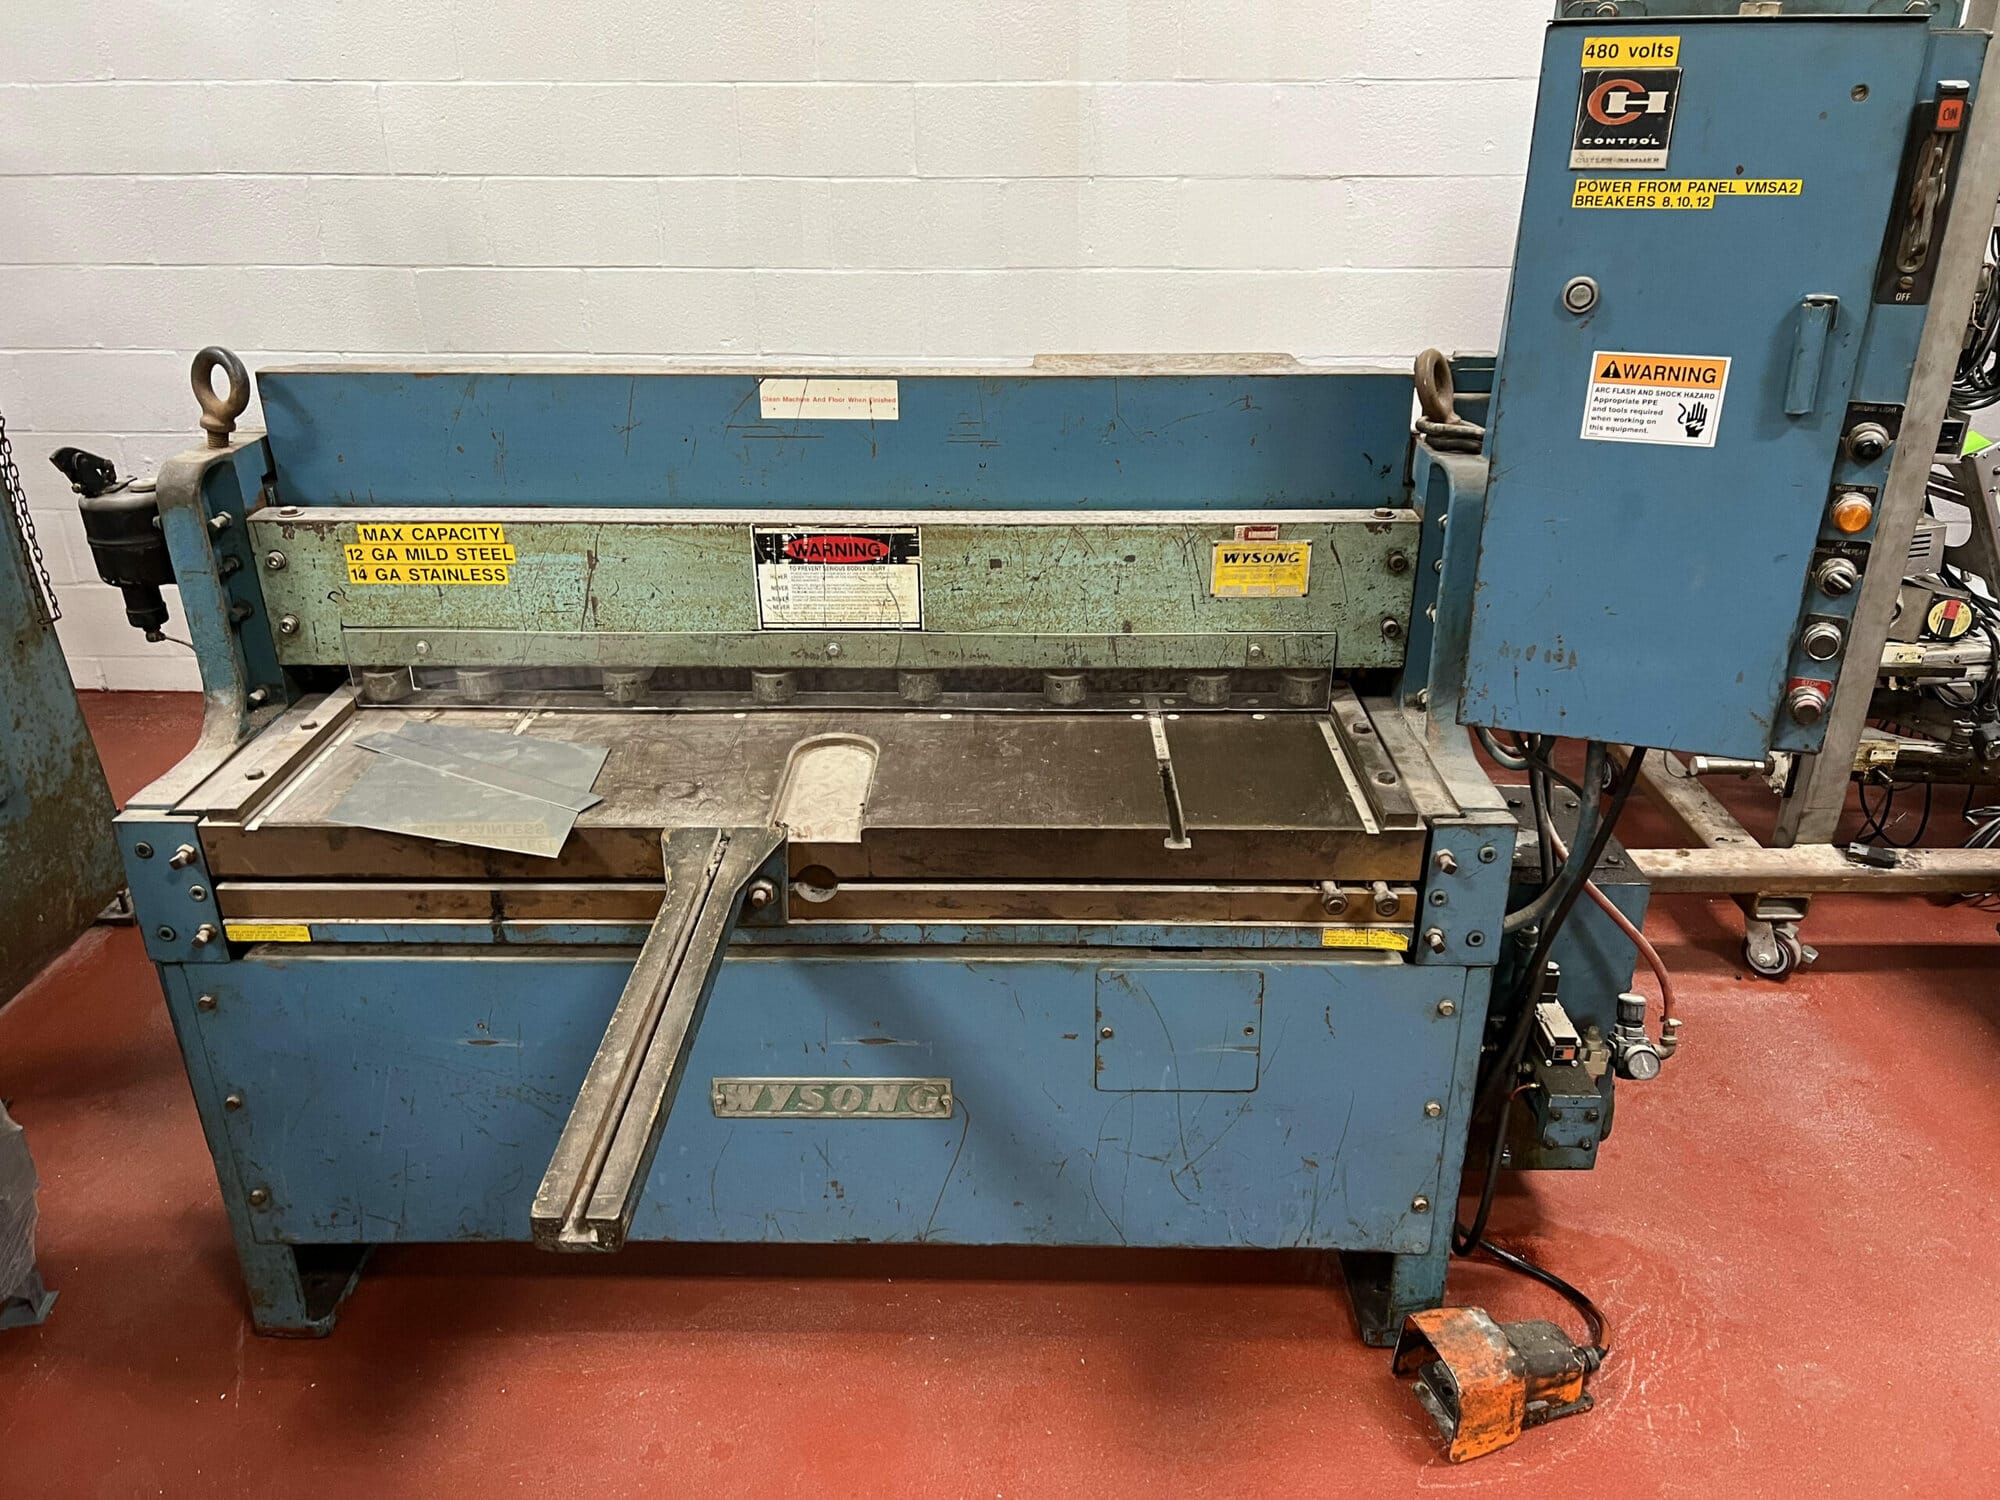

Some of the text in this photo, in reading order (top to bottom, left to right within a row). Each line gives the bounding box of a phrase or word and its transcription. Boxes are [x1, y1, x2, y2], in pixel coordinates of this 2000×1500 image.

[1584, 42, 1675, 59] 480 volts
[1942, 106, 1958, 121] ON
[1581, 136, 1661, 146] CONTROL
[1577, 180, 1799, 194] POWER FROM PANEL VMSA2
[1574, 195, 1656, 208] BREAKERS
[1895, 292, 1912, 302] OFF
[1623, 363, 1717, 384] WARNING
[1612, 387, 1637, 396] FLASH
[1637, 389, 1654, 397] AND
[1655, 390, 1682, 398] SHOCK
[1683, 391, 1715, 400] HAZARD
[1593, 396, 1659, 406] Appropriate PPE
[1608, 406, 1628, 414] tools
[1629, 408, 1664, 417] required
[1590, 415, 1611, 423] when
[1613, 416, 1645, 425] working
[1605, 425, 1649, 434] equipment.
[362, 527, 501, 541] MAX CAPACITY
[347, 548, 514, 561] 12 GA MILD STEEL
[791, 543, 881, 558] WARNING
[1223, 552, 1300, 564] WYSONG
[351, 568, 506, 581] 14 GA STAINLESS
[725, 1084, 941, 1113] WYSONG
